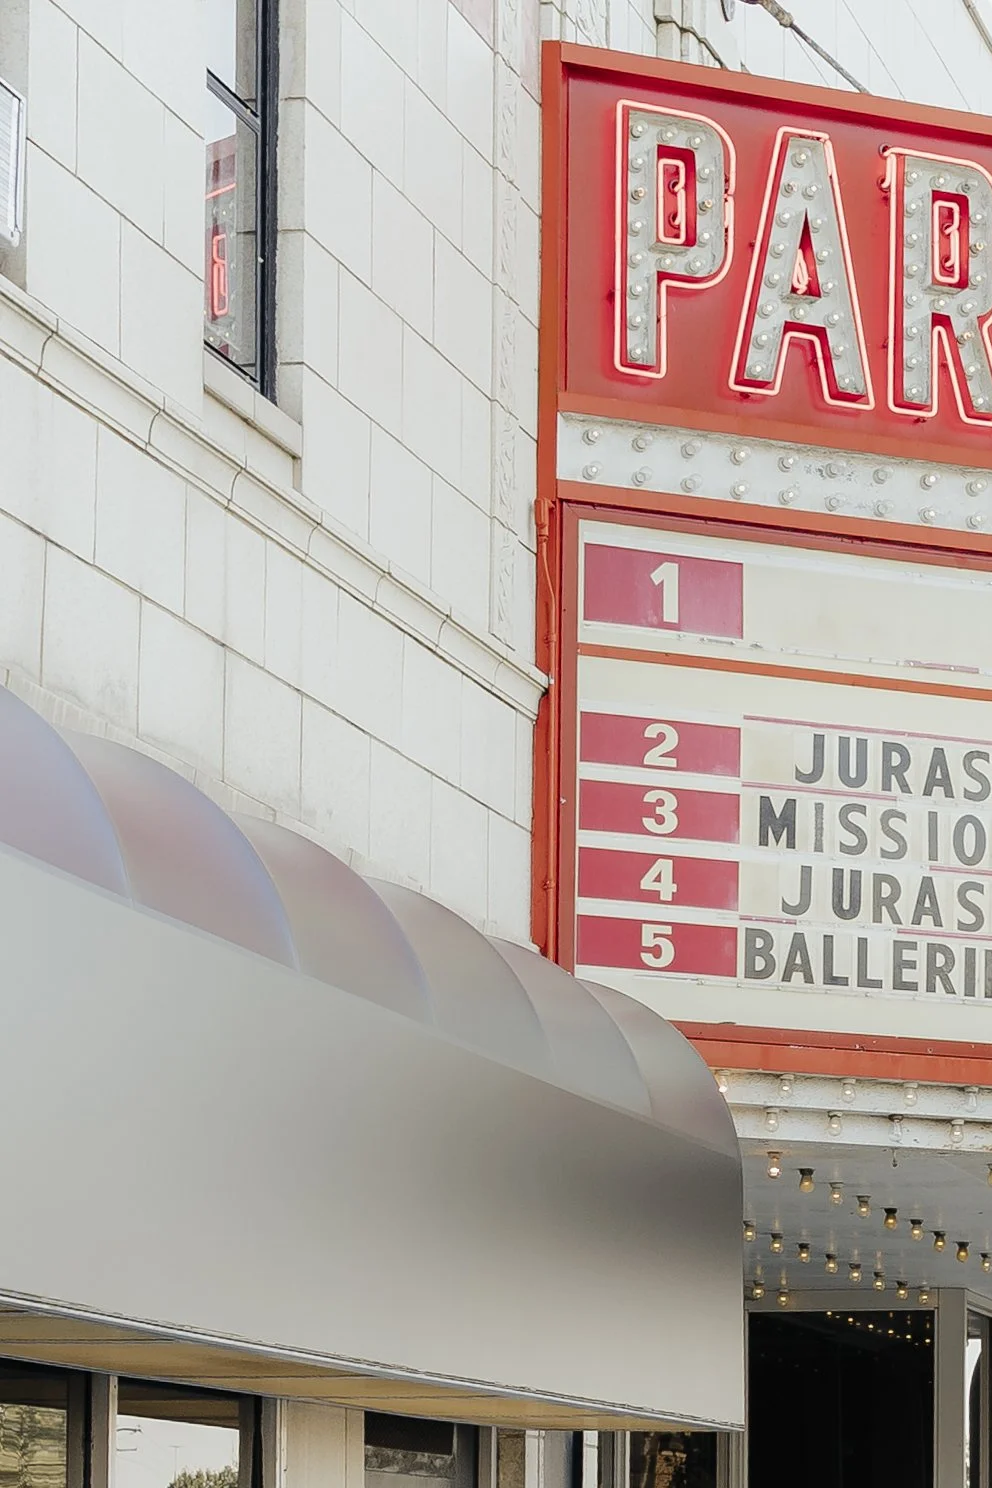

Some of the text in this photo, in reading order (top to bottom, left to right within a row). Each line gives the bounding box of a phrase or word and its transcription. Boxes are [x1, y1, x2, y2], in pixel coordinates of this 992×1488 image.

[649, 561, 680, 624] 1
[643, 723, 680, 769] 2
[641, 789, 679, 834] 3
[640, 859, 677, 902] 4
[640, 924, 676, 968] 5
